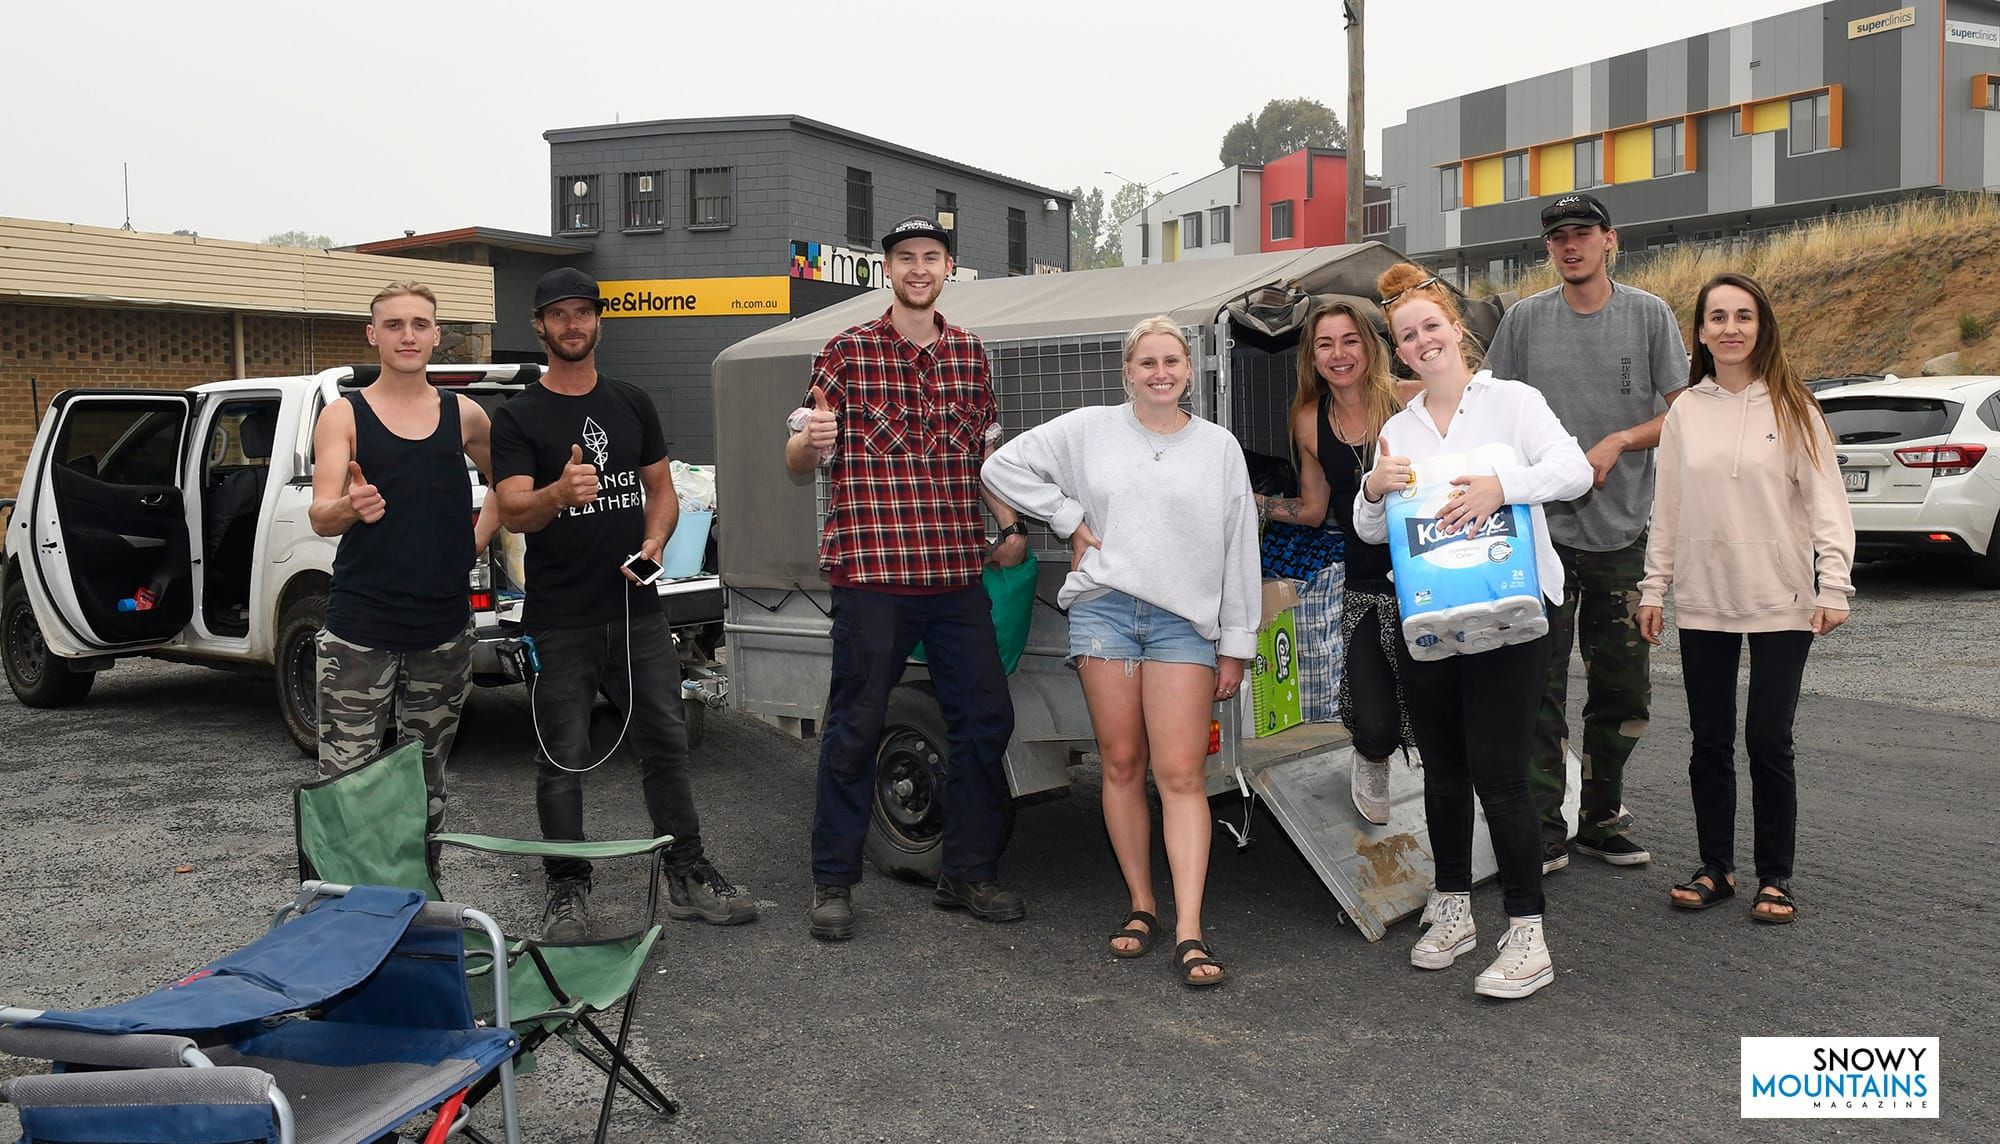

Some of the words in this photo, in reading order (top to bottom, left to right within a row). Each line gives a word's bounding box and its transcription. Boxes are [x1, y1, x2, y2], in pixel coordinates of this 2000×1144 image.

[1857, 12, 1912, 33] superclinics
[1951, 28, 1998, 42] superclinics
[731, 299, 778, 310] rh.com.au
[1842, 473, 1866, 487] 6DY
[558, 491, 640, 518] EATHERS
[1511, 569, 1524, 577] 24
